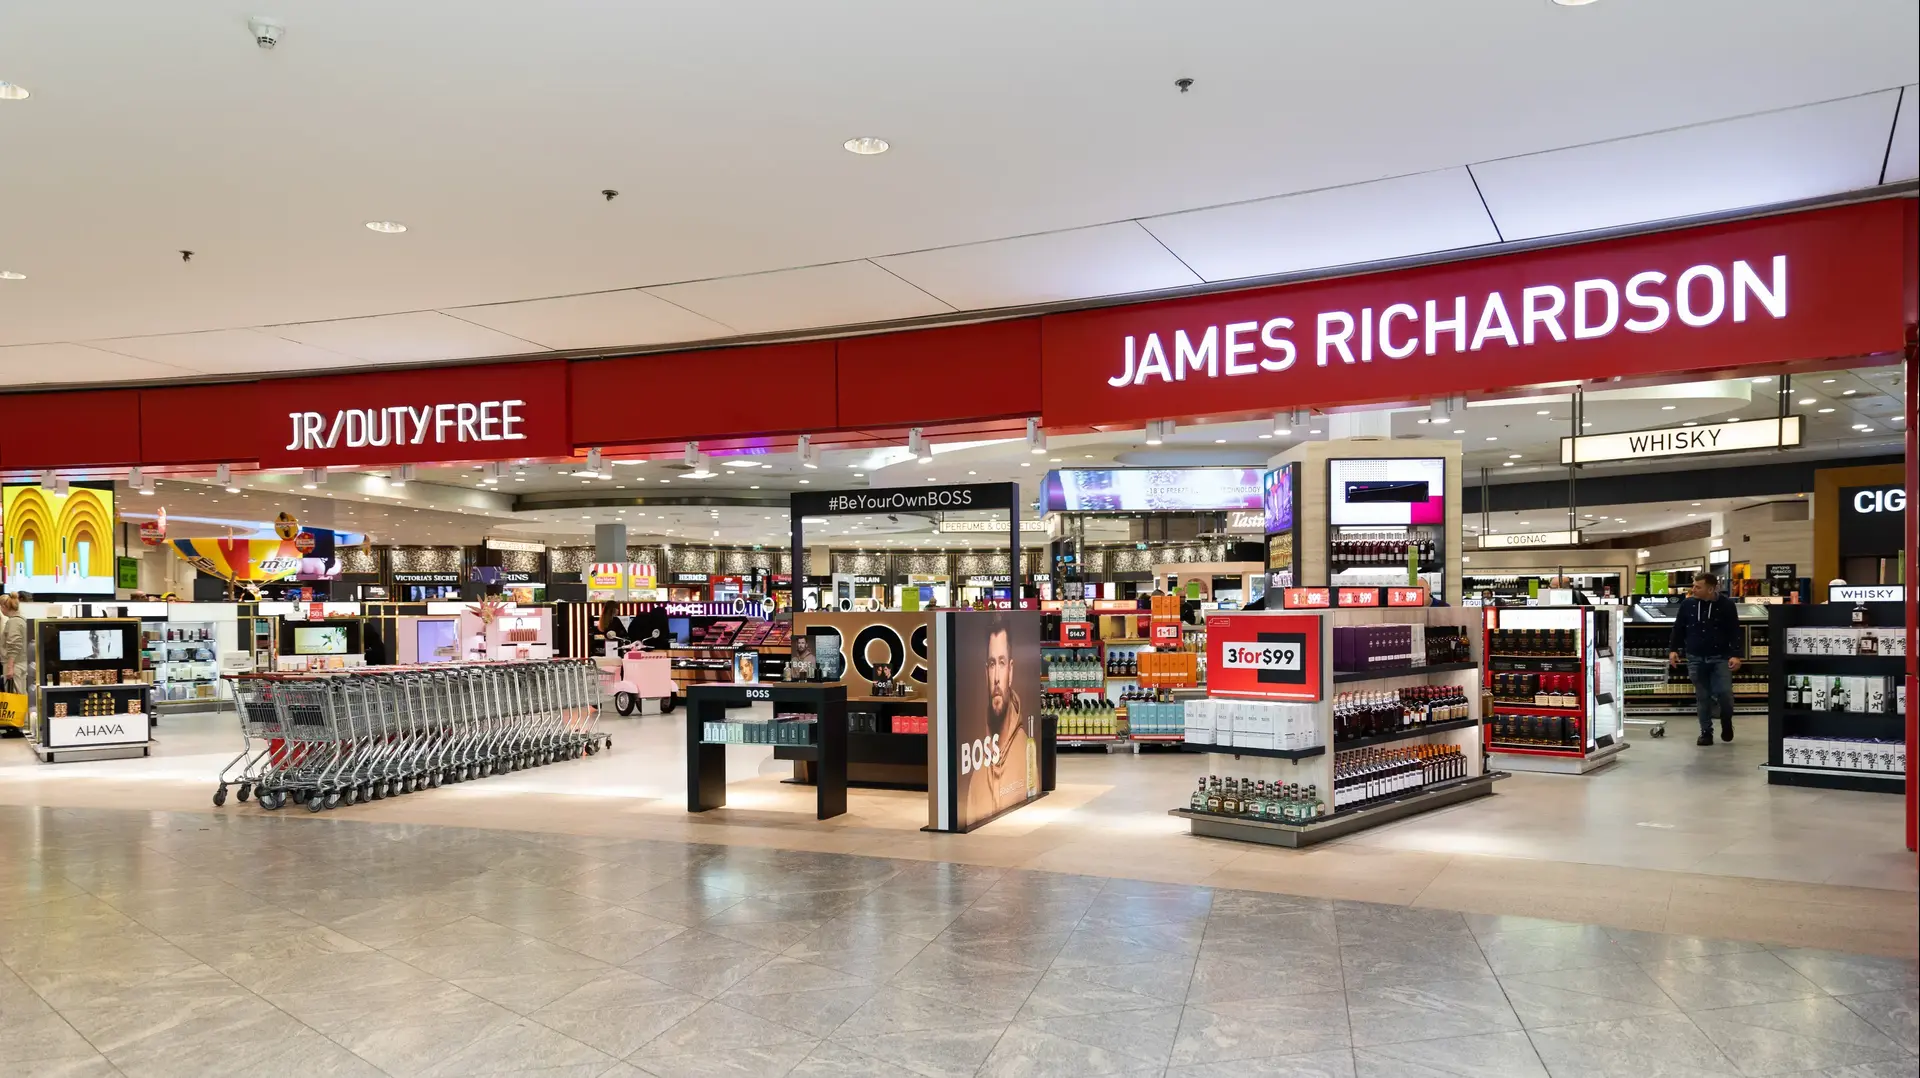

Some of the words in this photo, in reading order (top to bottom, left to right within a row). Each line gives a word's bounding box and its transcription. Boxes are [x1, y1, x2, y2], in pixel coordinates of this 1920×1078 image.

[1107, 317, 1297, 388] JAMES
[1316, 255, 1787, 368] RICHARDSON
[1629, 429, 1722, 453] WHISKY
[828, 489, 972, 511] #BeYourOwnBOSS
[945, 522, 985, 531] PERFUME
[987, 522, 994, 530] &
[996, 522, 1042, 531] COSETICS
[1507, 534, 1547, 545] COGNAC
[1178, 554, 1226, 563] GUCCI
[1033, 574, 1050, 582] DIOR
[1841, 590, 1894, 599] WHISKY
[1227, 647, 1295, 666] 3for$99
[792, 660, 811, 668] BOSS
[745, 689, 770, 698] BOSS
[75, 724, 124, 737] AHAVA
[961, 733, 1000, 775] BOSS
